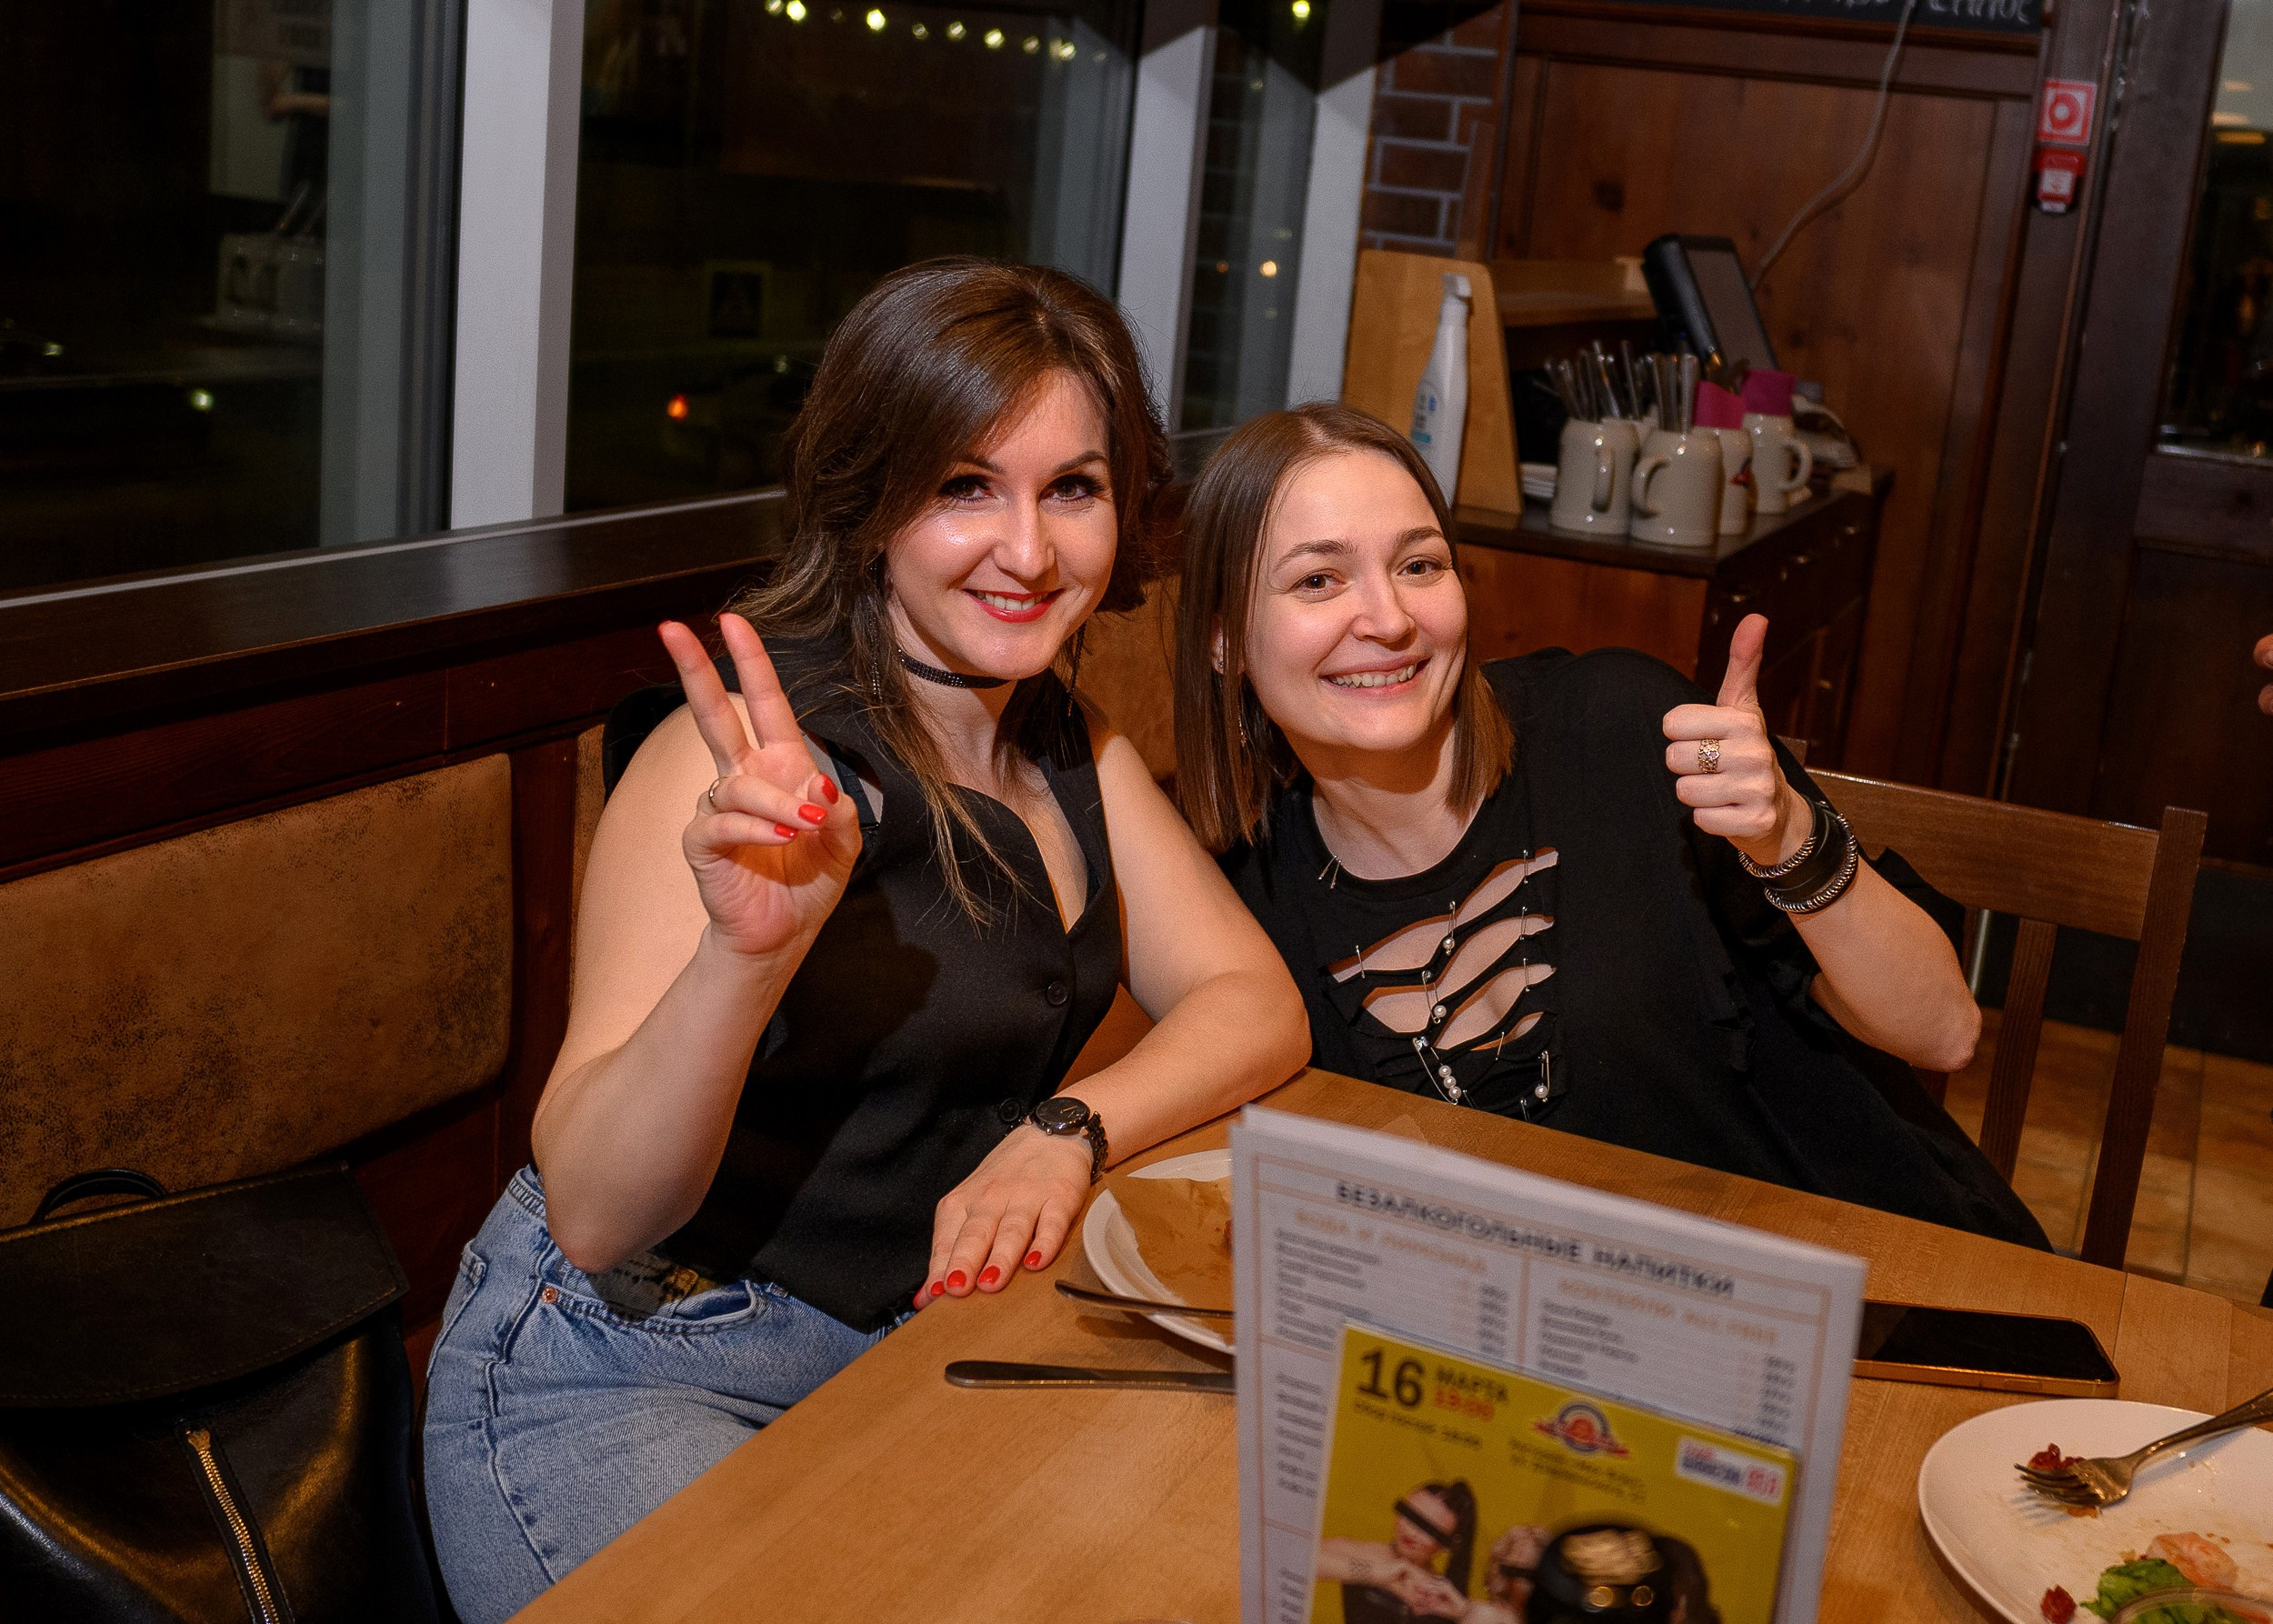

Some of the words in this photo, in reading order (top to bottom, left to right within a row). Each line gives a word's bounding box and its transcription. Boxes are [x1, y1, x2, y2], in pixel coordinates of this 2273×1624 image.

[1337, 1182, 1582, 1264] БЕЗАЛКОГОЛЬНЫЕ
[1593, 1244, 1735, 1298] НАПИТКИ
[1357, 1347, 1426, 1408] 16
[1436, 1365, 1510, 1404] МАРТА
